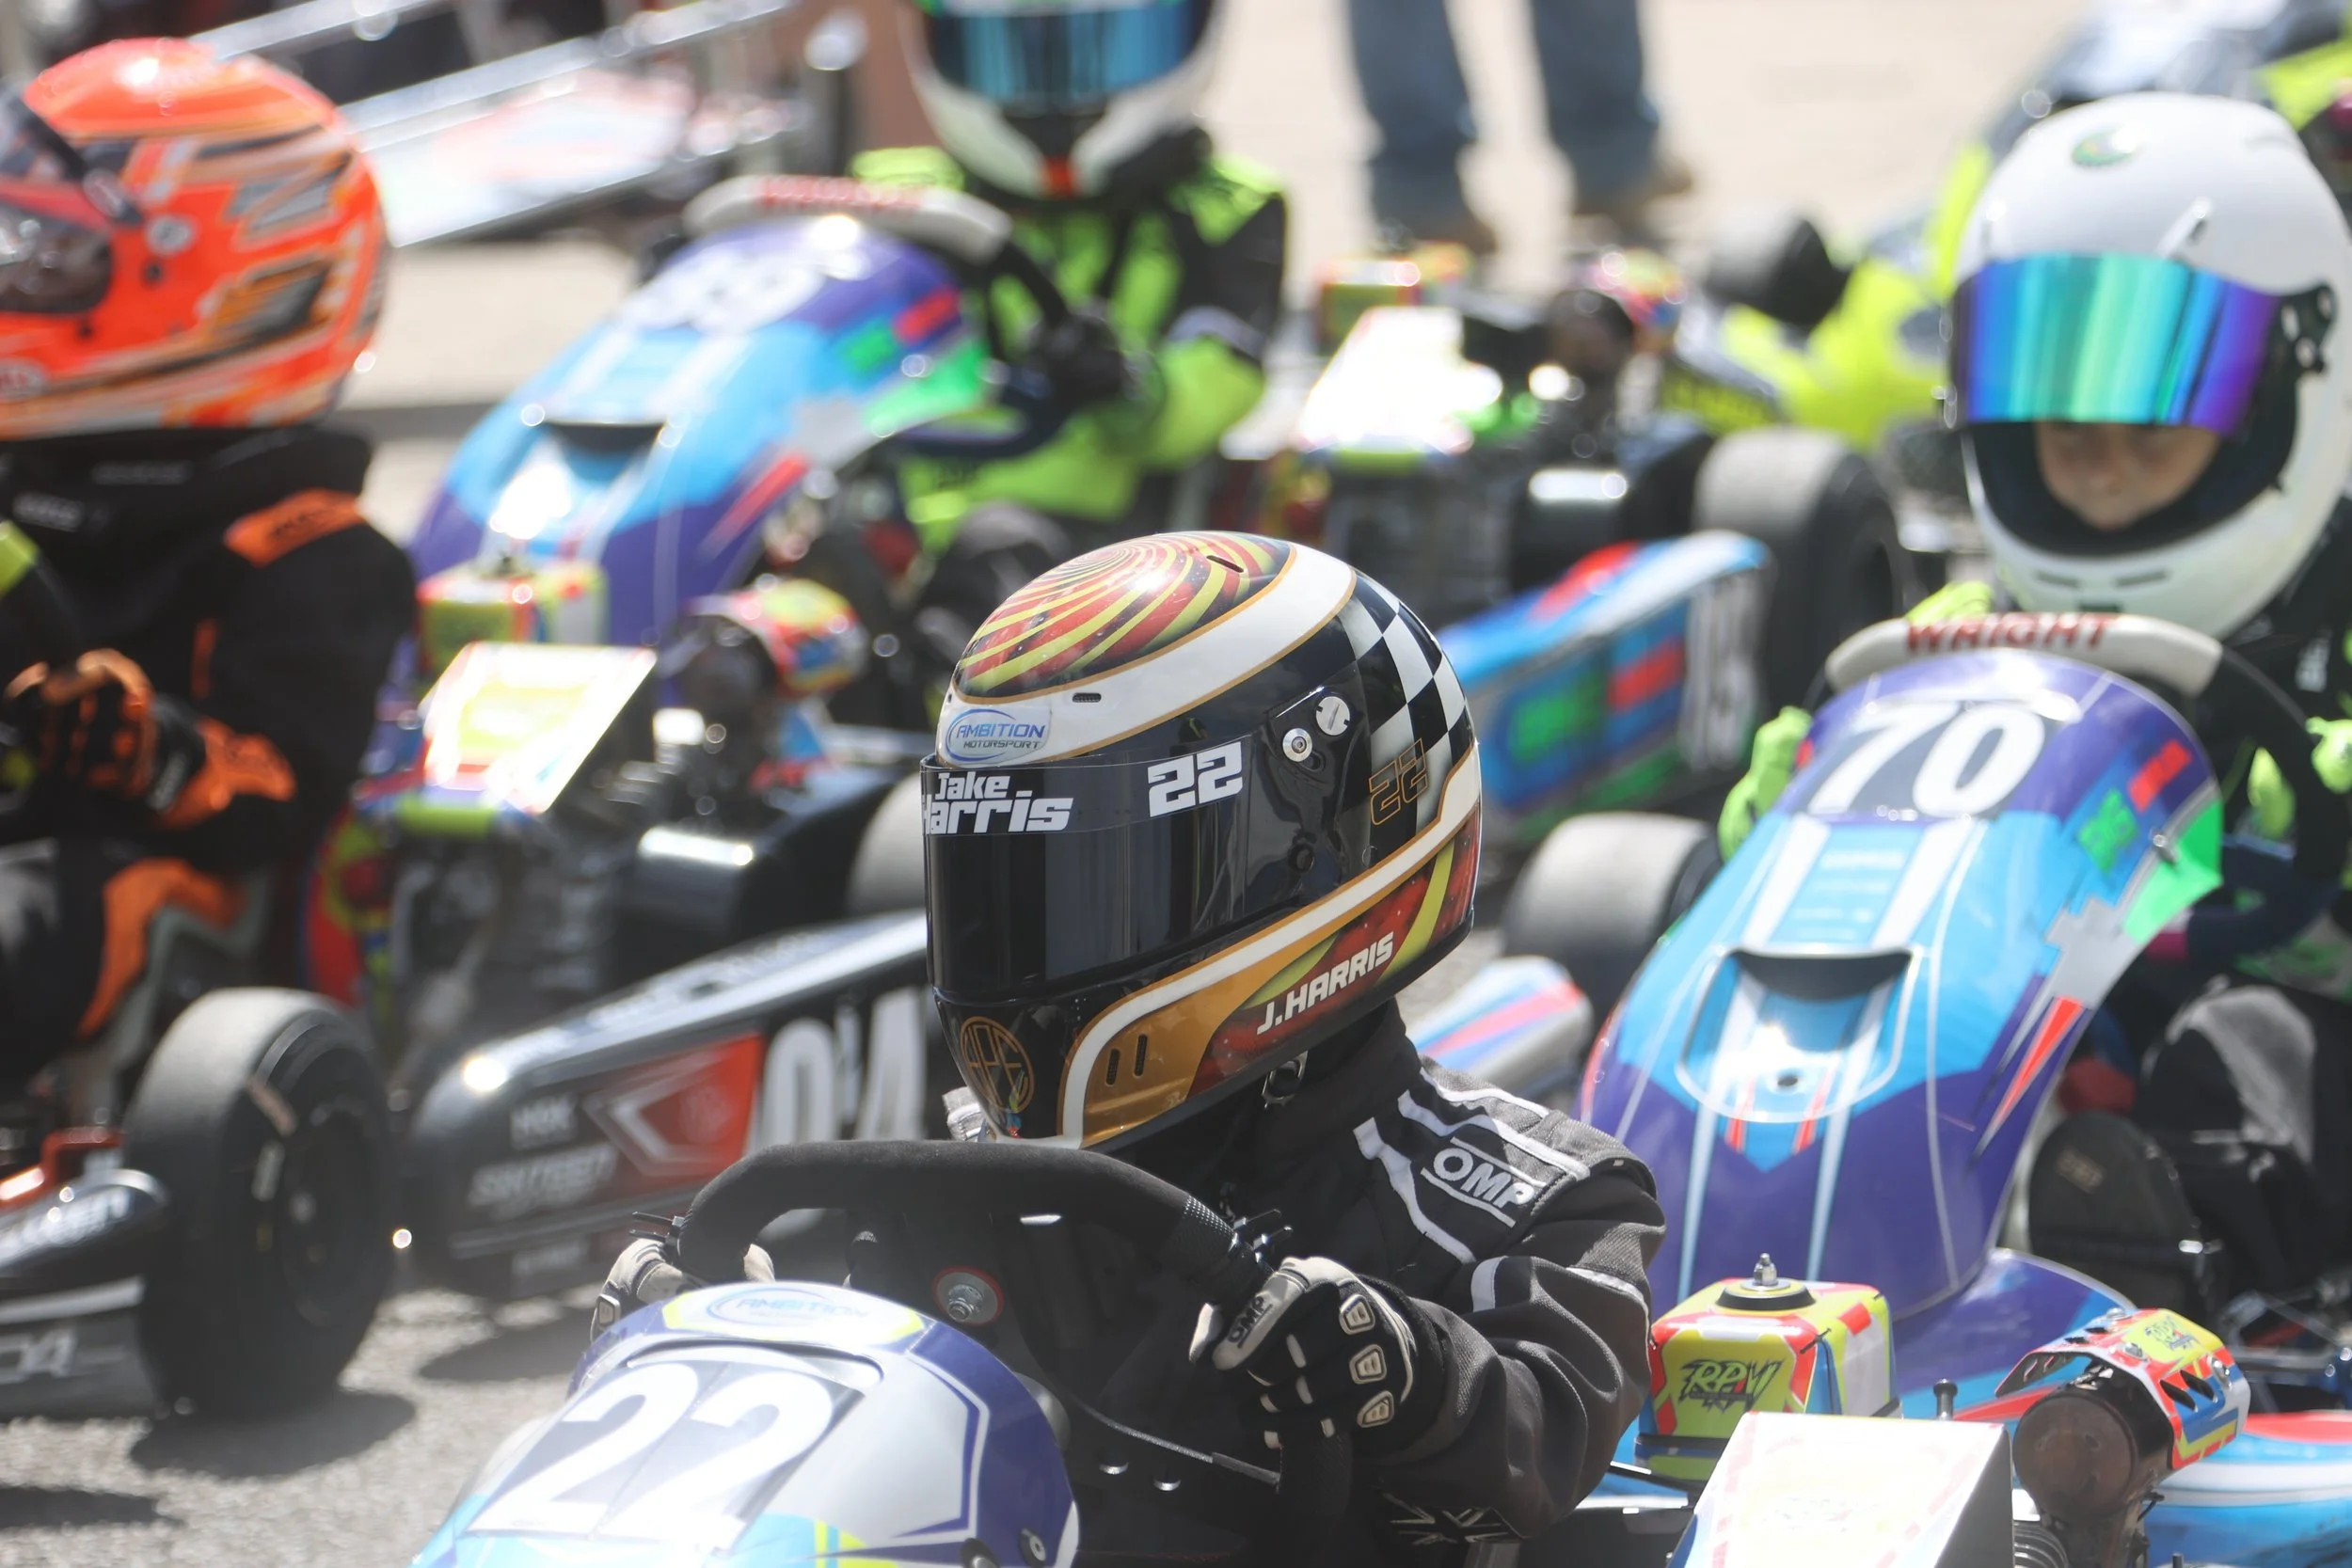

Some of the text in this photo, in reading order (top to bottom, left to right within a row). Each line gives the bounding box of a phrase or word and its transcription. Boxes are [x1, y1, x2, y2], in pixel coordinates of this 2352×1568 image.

[1906, 611, 2115, 652] WRIGHT
[956, 723, 1046, 739] AMBITION
[963, 739, 1042, 749] MOTORSPORT
[1808, 700, 2044, 816] 70
[935, 771, 1010, 800] Jake
[1147, 741, 1244, 817] 22
[1369, 738, 1428, 825] 22
[1257, 931, 1393, 1035] J.HARRIS
[1433, 1148, 1535, 1209] OMP
[1227, 1296, 1265, 1344] OMP
[1678, 1358, 1785, 1412] RPM
[461, 1362, 834, 1550] 22
